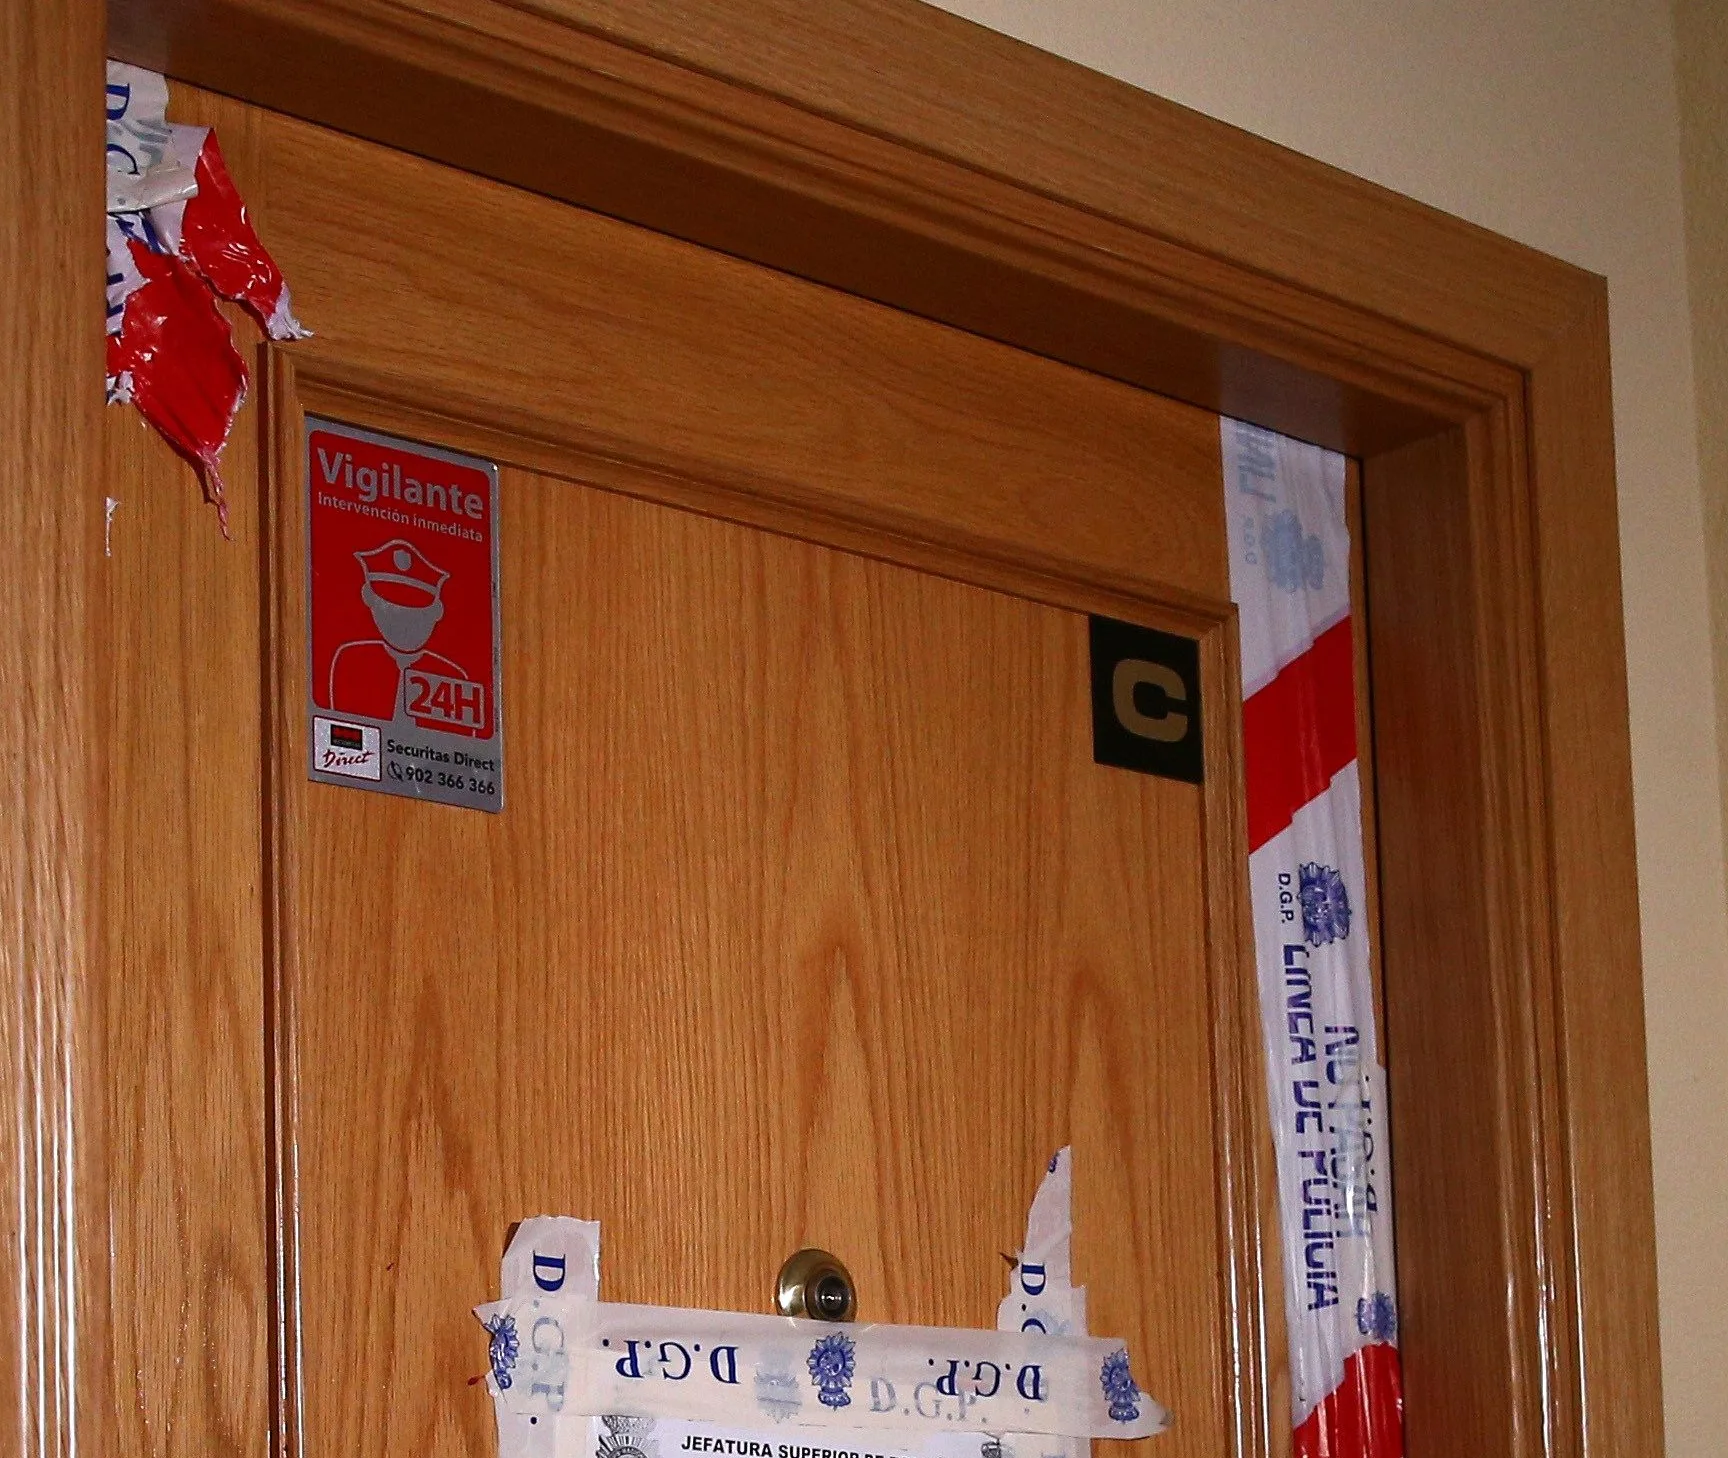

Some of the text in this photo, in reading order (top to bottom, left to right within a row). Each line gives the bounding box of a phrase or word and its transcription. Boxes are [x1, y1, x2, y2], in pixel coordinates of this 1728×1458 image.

[317, 447, 483, 519] Vigilante
[318, 491, 483, 542] Intervención inmediata
[409, 676, 480, 726] 24H
[1112, 658, 1188, 742] C
[387, 739, 495, 772] Securitas Direct
[406, 765, 496, 796] 902 366 366
[602, 1338, 741, 1385] D.G.P.
[928, 1358, 1043, 1401] D.G.P.
[681, 1435, 773, 1458] JEFATURA
